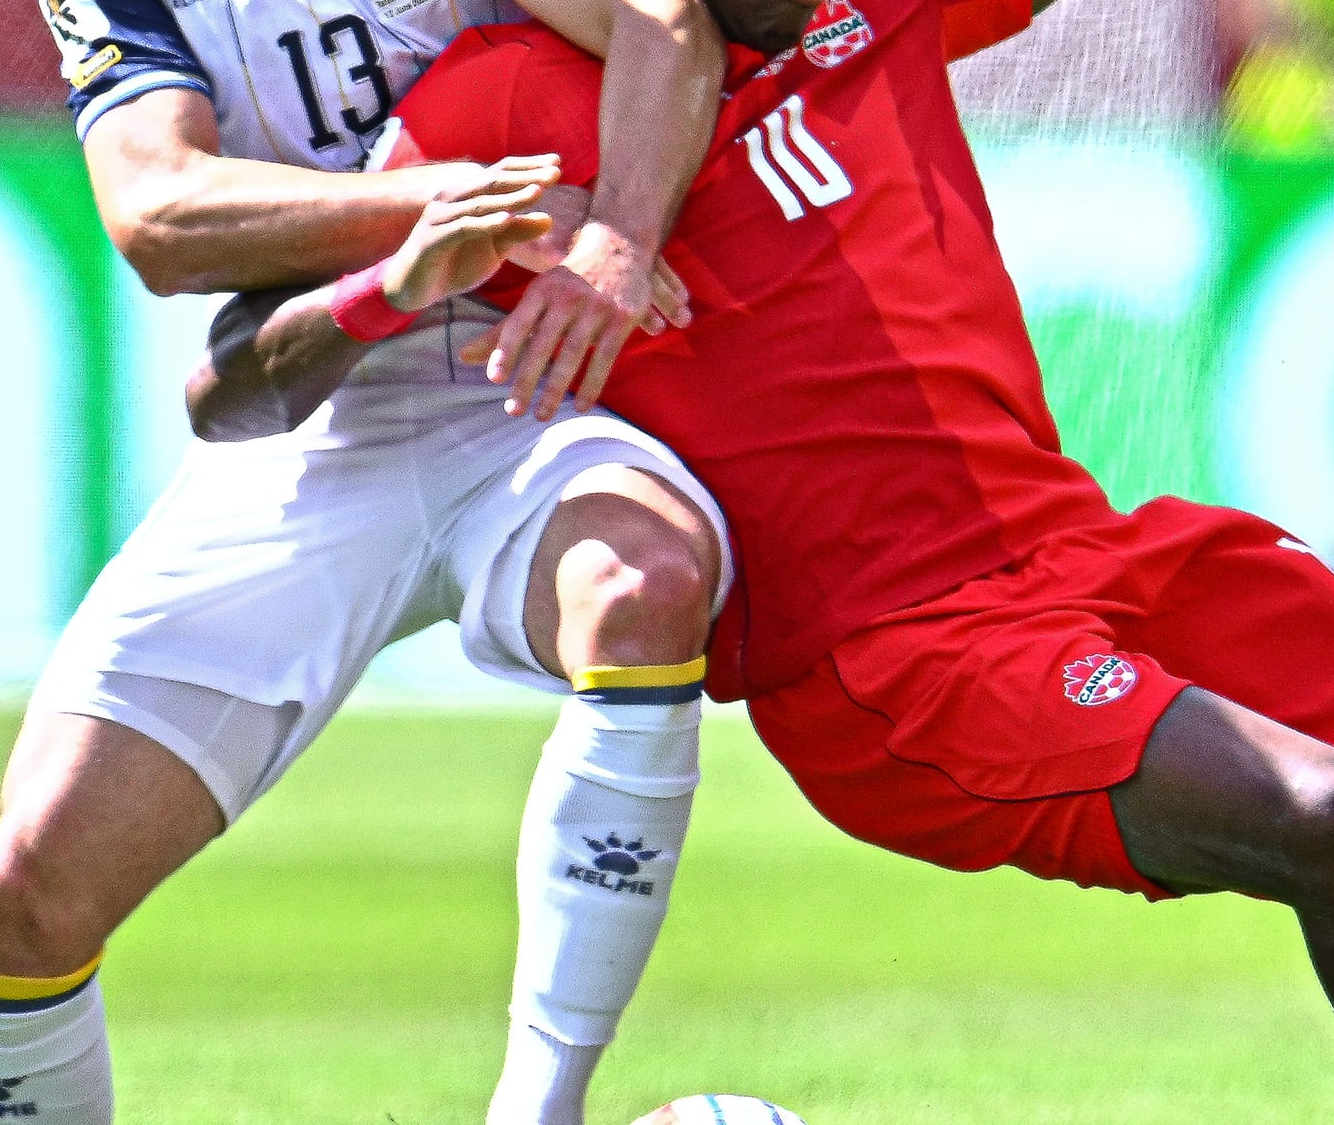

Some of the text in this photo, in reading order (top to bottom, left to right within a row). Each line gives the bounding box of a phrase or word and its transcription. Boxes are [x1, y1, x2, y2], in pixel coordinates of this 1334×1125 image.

[803, 16, 865, 51] CANADA
[276, 14, 392, 151] 13
[734, 92, 855, 222] 10
[1079, 657, 1121, 704] CANADA
[566, 863, 655, 896] KELME
